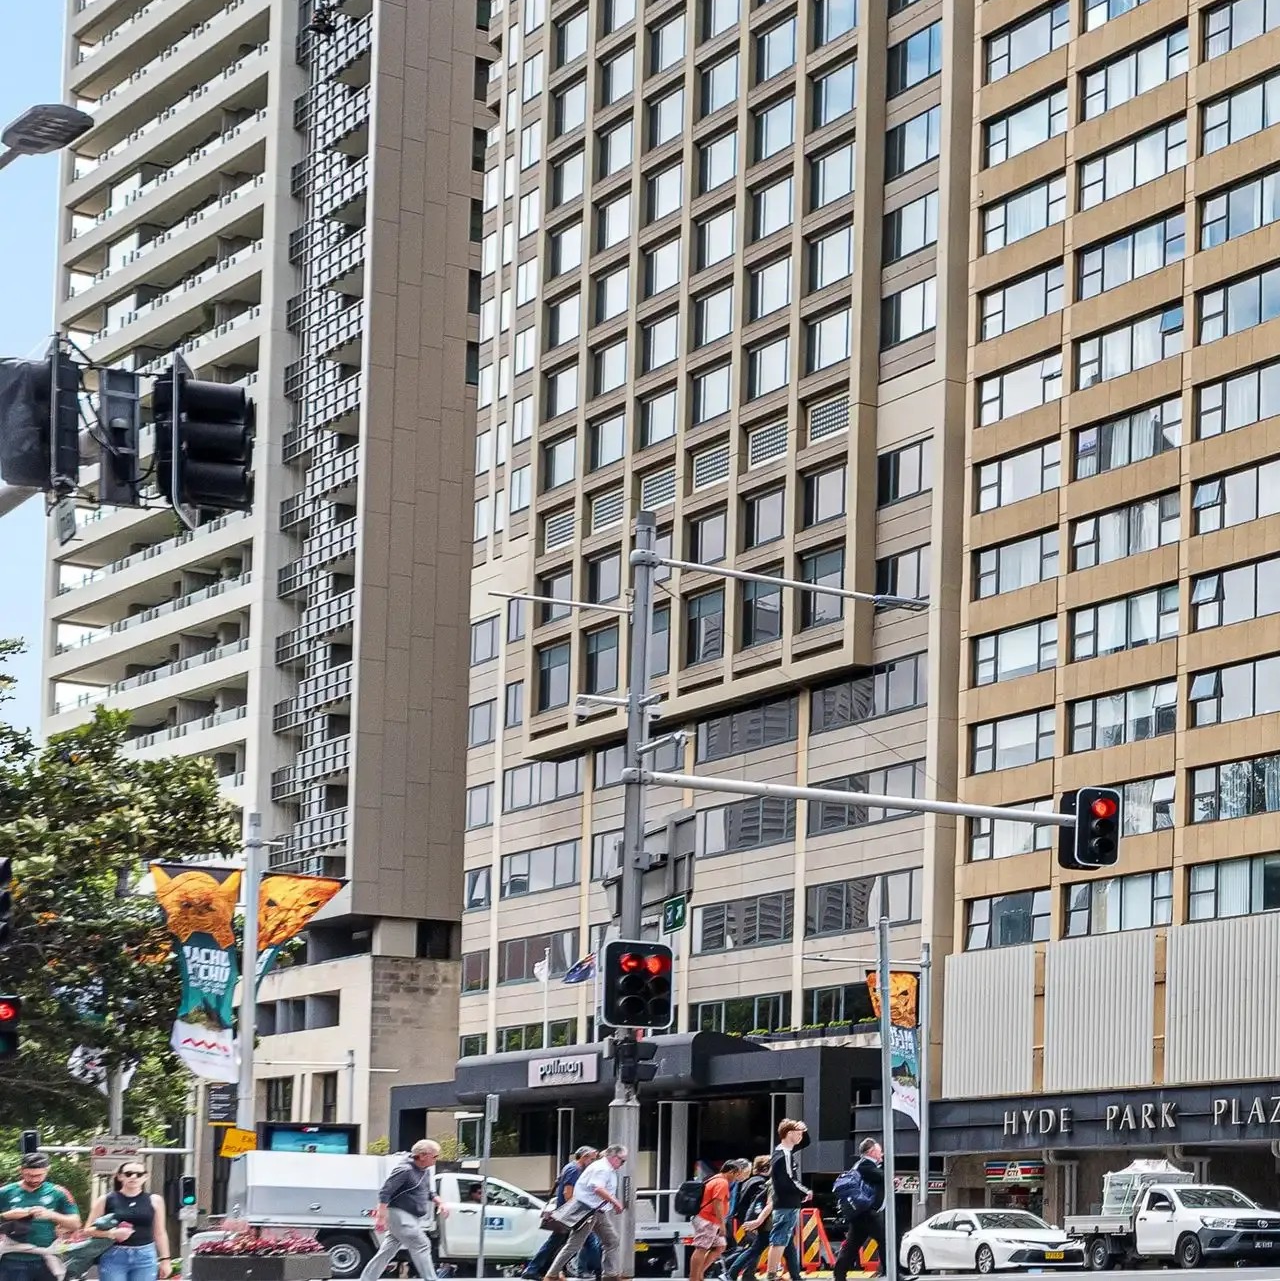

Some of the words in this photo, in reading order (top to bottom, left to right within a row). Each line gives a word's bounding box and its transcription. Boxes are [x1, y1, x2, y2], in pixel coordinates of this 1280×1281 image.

[539, 1059, 583, 1079] pullman
[1003, 1107, 1072, 1136] HYDE
[1105, 1101, 1177, 1131] PARK
